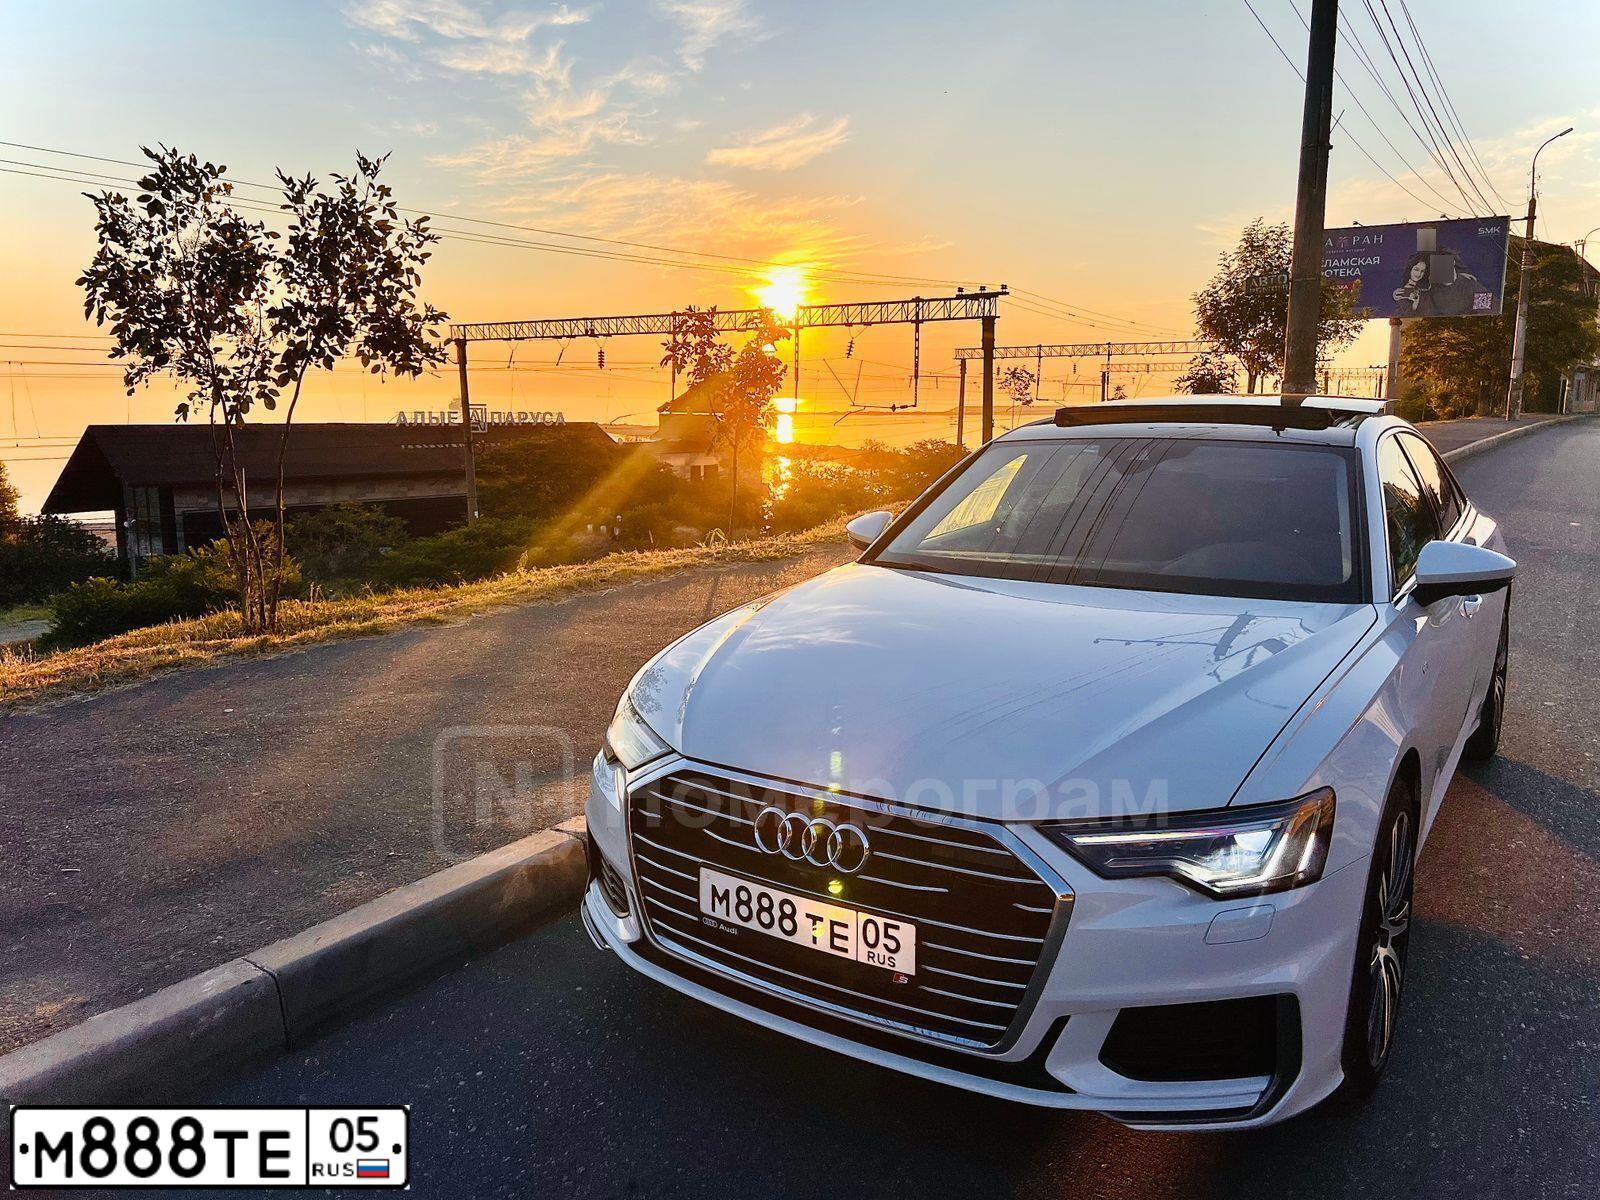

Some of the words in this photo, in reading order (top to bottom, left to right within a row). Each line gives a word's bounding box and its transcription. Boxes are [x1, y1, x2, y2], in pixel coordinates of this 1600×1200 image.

[1321, 256, 1380, 268] ЛАМСКАЯ
[1321, 267, 1362, 278] ОТЕКА
[395, 410, 459, 428] АЛЫЕ
[490, 410, 567, 427] ПАРУСА
[718, 923, 738, 935] Audi
[862, 918, 901, 954] 05
[868, 950, 896, 968] RUS
